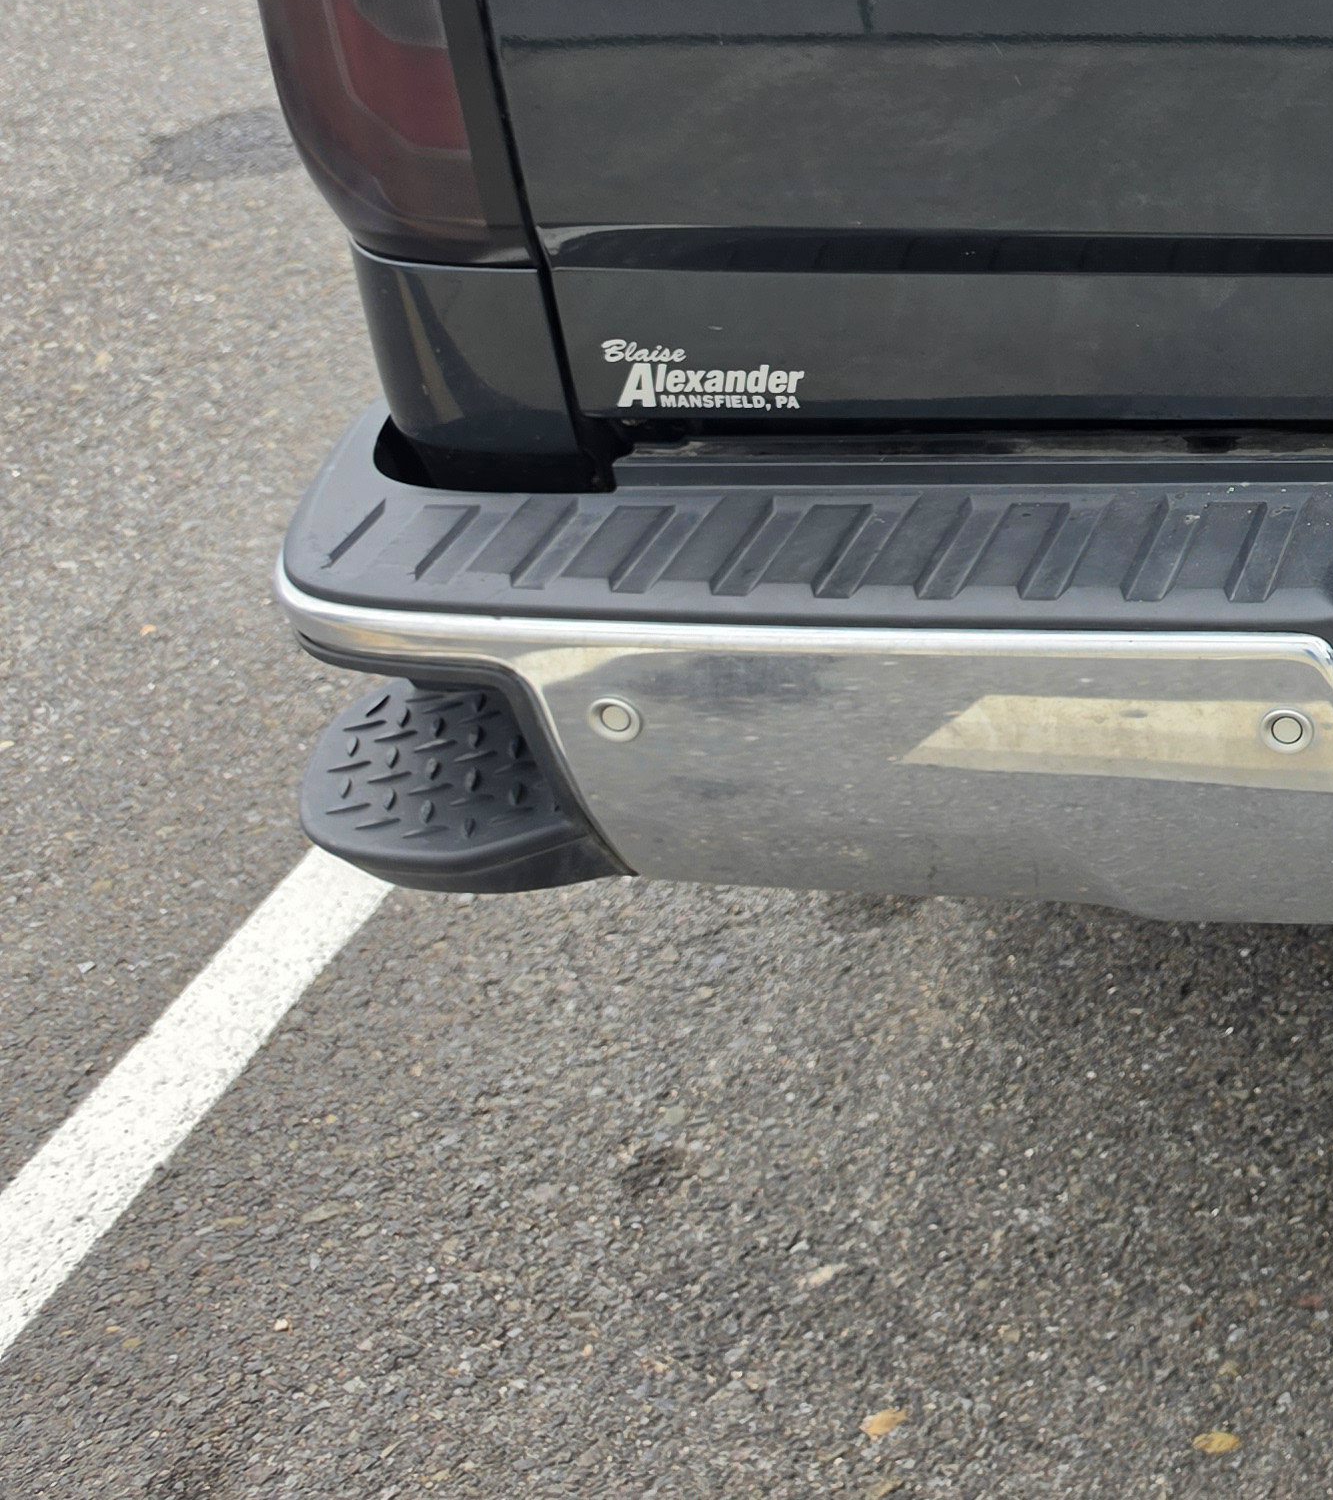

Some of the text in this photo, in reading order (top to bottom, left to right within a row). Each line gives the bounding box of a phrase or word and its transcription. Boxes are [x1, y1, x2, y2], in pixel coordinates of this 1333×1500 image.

[601, 338, 687, 363] Blaise
[617, 362, 805, 408] Alexander
[660, 395, 801, 412] MANSFIELD, PA
